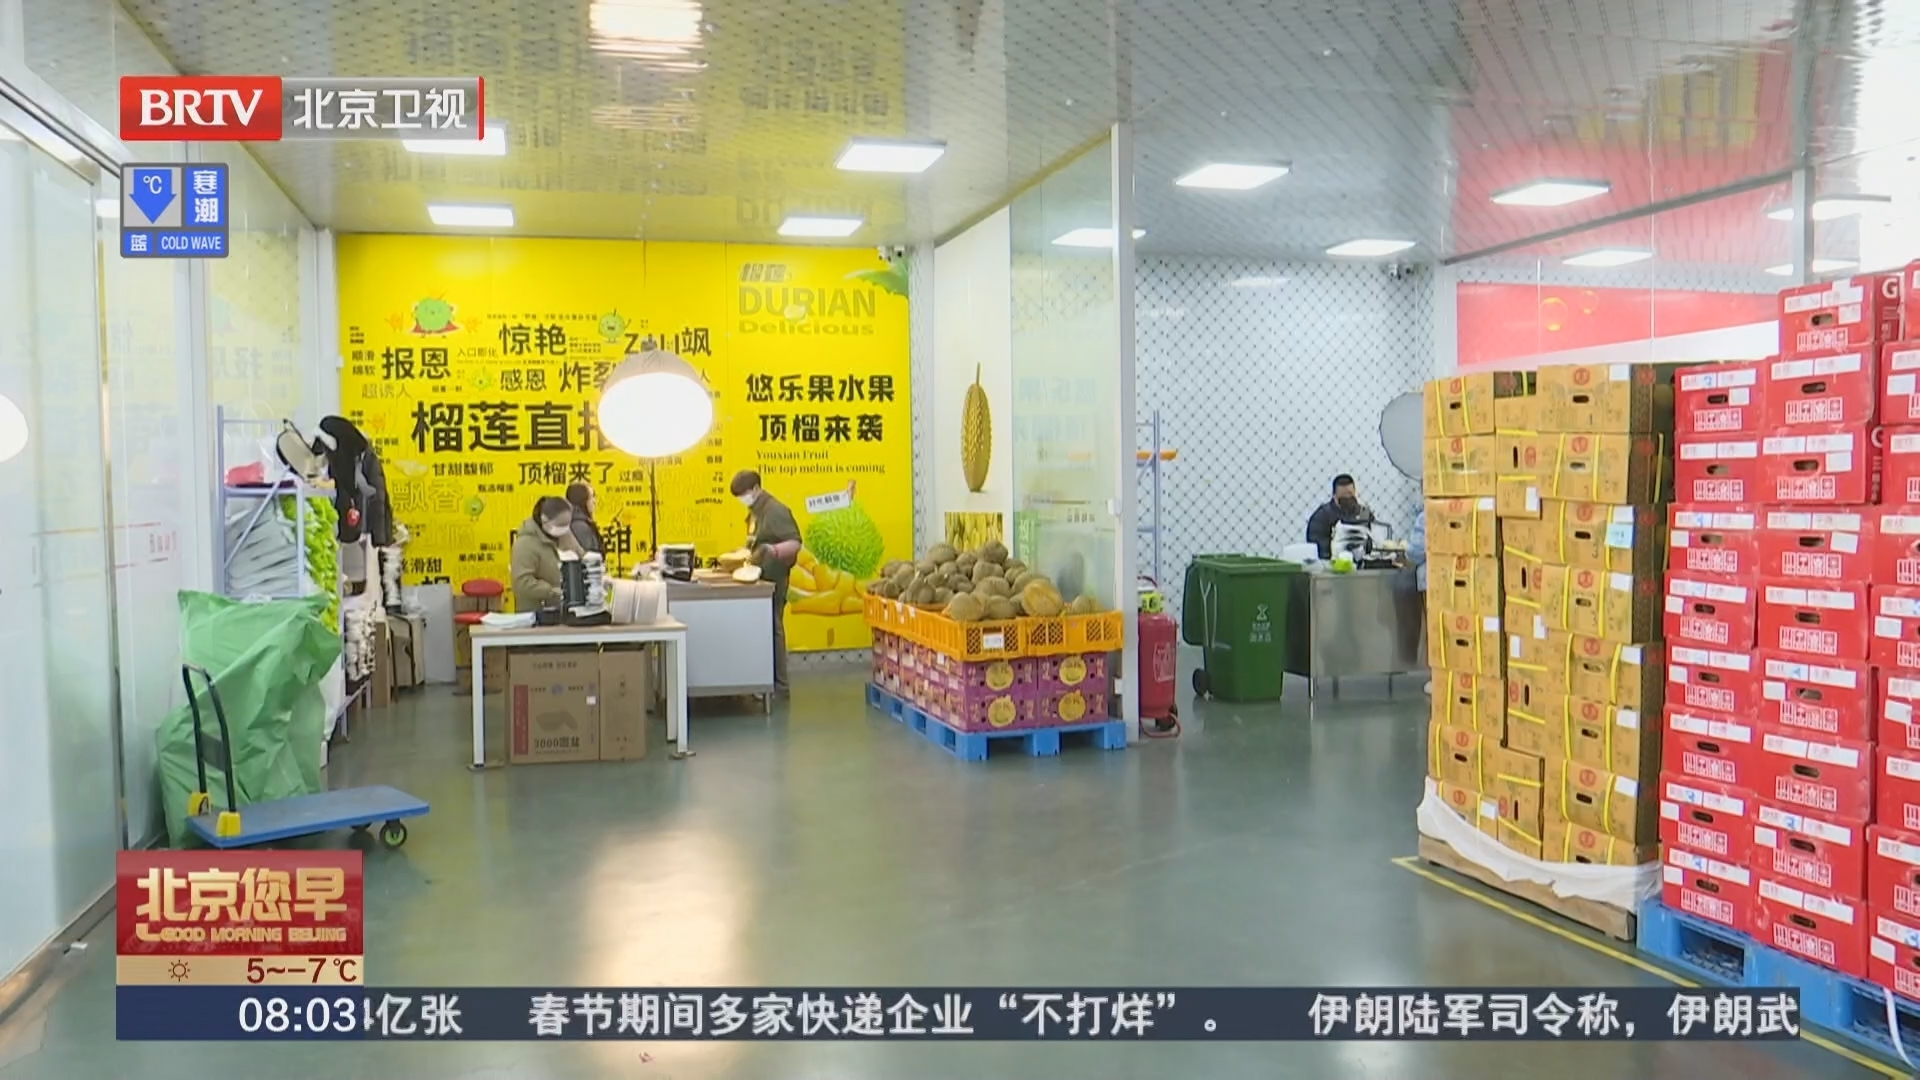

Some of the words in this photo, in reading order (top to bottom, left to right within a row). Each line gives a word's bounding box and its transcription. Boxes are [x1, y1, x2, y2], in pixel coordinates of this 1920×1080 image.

[739, 287, 876, 317] DURIAN
[498, 323, 567, 355] 惊艳
[739, 320, 875, 335] Delicious
[382, 346, 451, 380] 报恩
[500, 368, 547, 392] 感恩
[746, 373, 895, 403] 悠乐果水果
[759, 413, 884, 443] 顶榴来袭
[803, 450, 829, 460] Fruit
[432, 462, 494, 477] 甘甜馥郁
[518, 462, 614, 486] 顶榴来了
[758, 464, 777, 474] The
[780, 465, 797, 477] top
[800, 464, 833, 474] melon
[836, 464, 843, 474] is
[845, 465, 885, 477] coming
